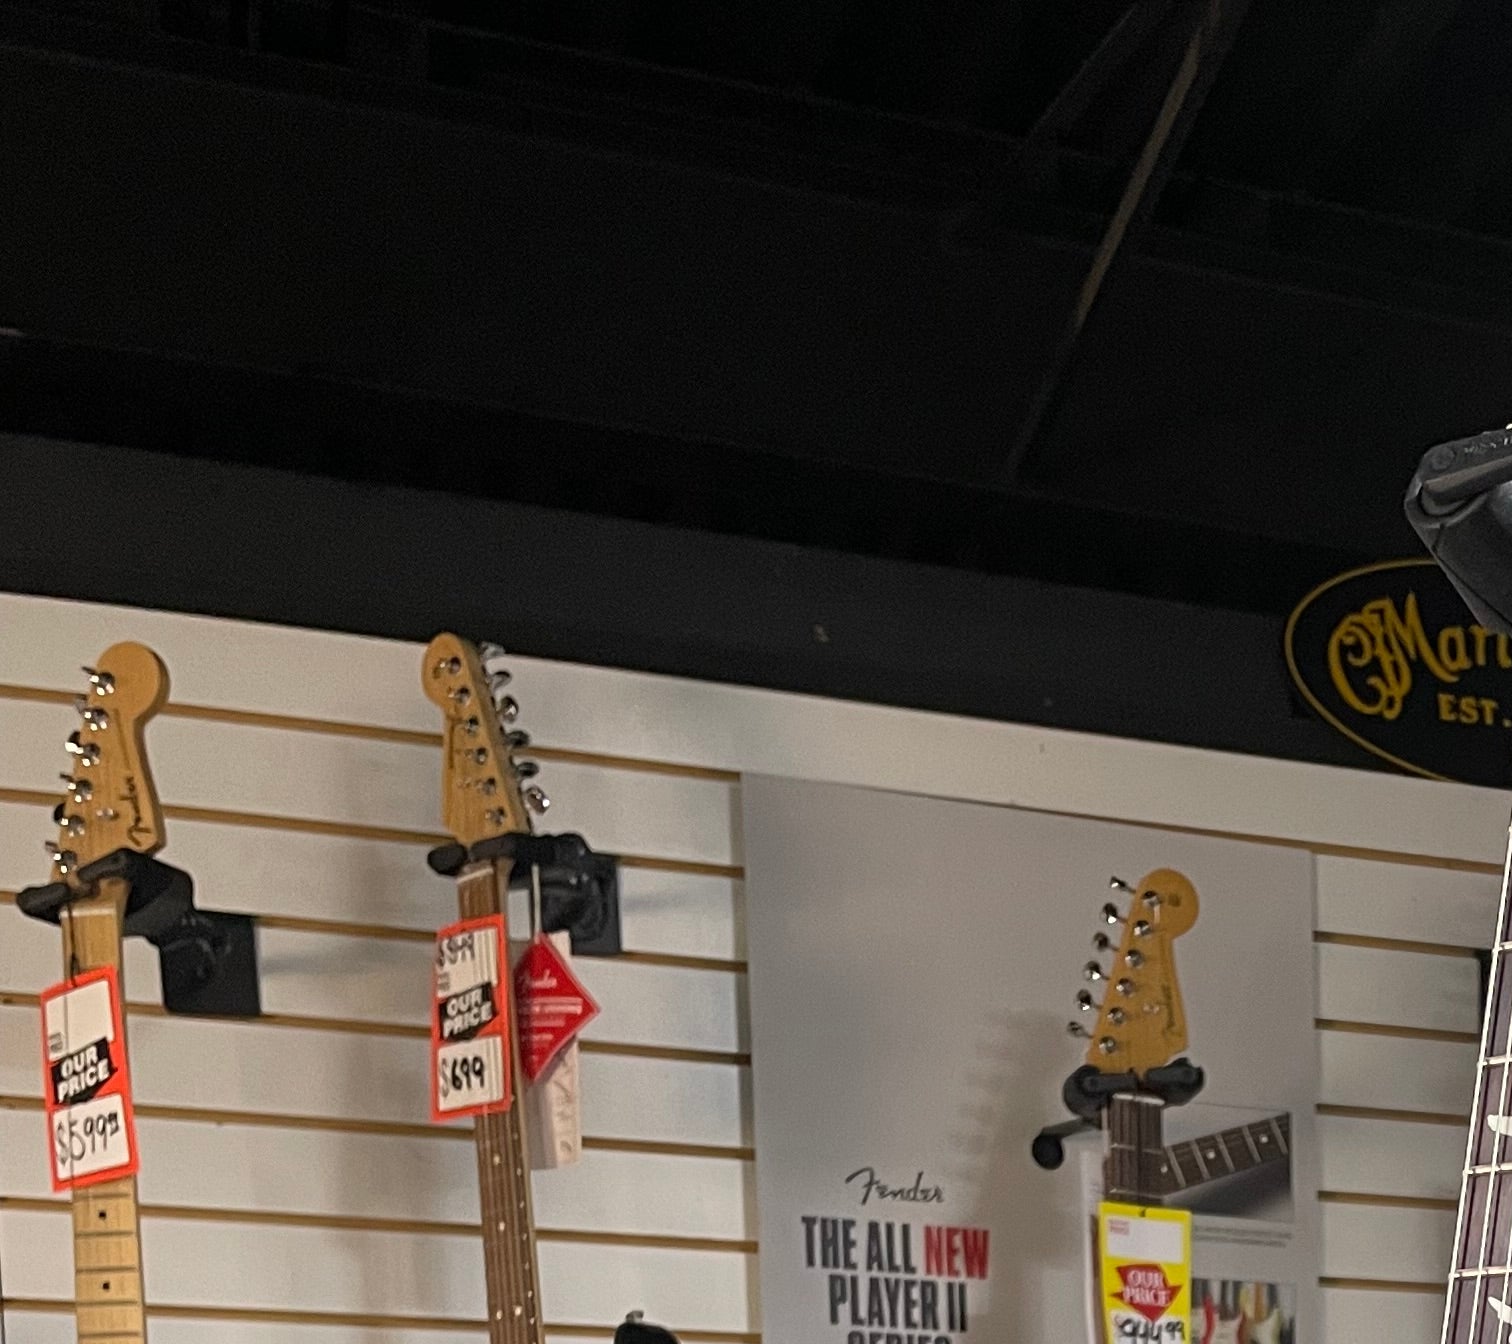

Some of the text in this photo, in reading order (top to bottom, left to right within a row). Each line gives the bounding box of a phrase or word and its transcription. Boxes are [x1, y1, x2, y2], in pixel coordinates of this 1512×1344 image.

[1437, 692, 1512, 728] EST.
[442, 1001, 493, 1038] PRICE
[447, 988, 484, 1018] OUR
[60, 1044, 98, 1078] OUR
[439, 1055, 485, 1098] $699
[57, 1062, 110, 1104] PRICE
[845, 1166, 946, 1206] Fender
[801, 1214, 990, 1281] THE ALL NEW
[1122, 1287, 1173, 1307] PRICE
[1126, 1269, 1165, 1288] OUR
[828, 1274, 968, 1334] PLAYER II
